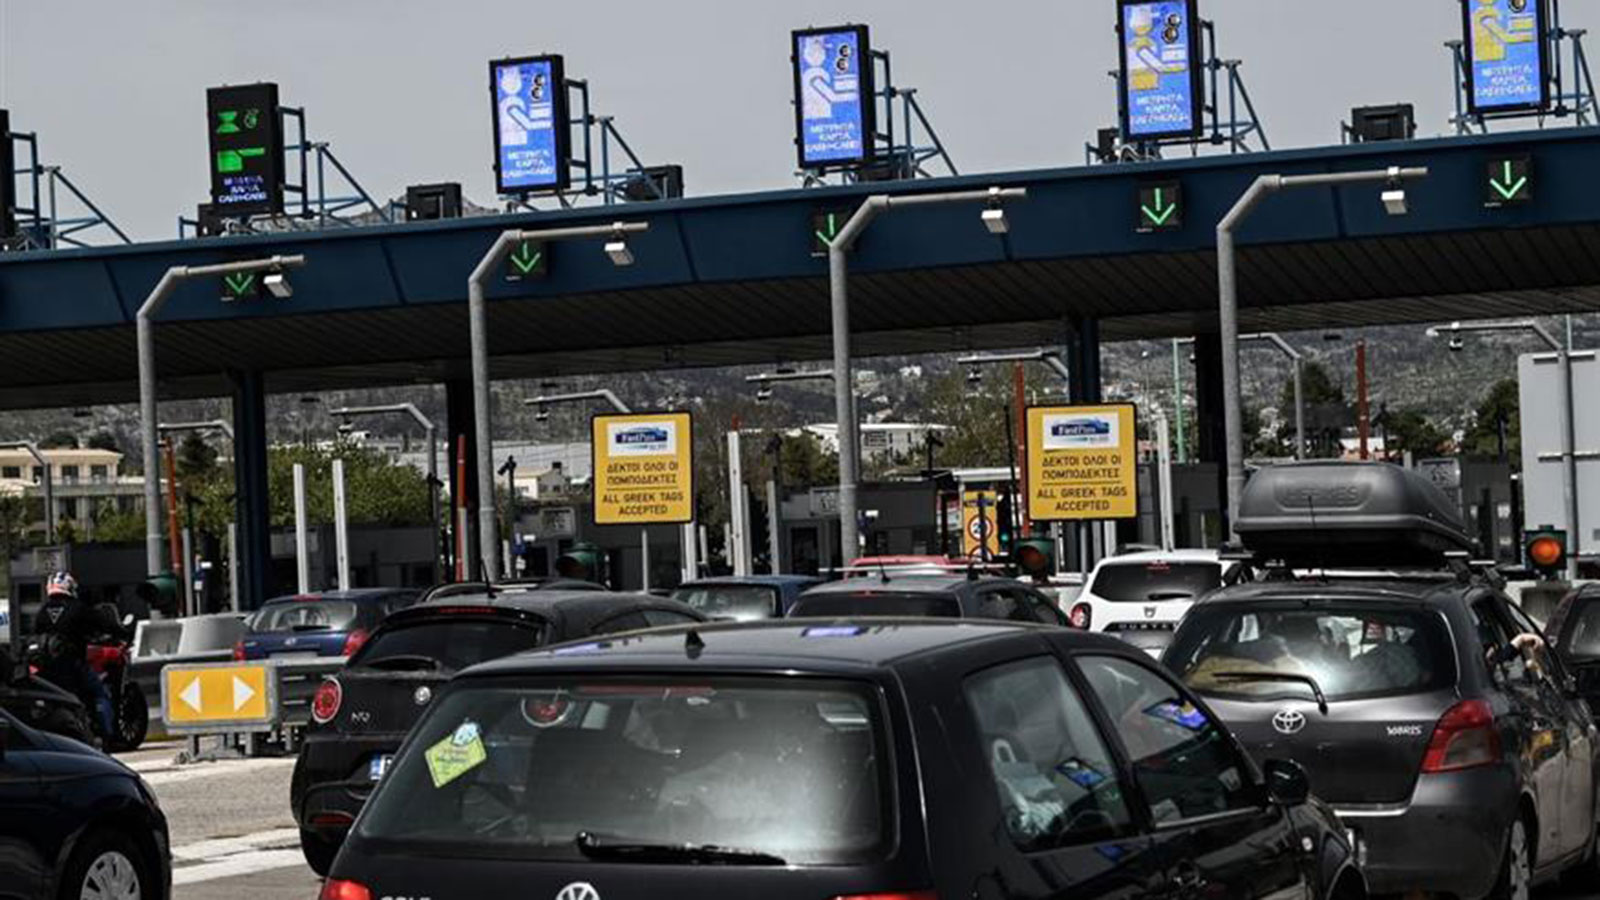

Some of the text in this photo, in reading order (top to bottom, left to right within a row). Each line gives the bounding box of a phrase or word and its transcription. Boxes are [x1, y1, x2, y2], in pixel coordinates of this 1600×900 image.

[607, 461, 679, 473] ΔΕΚΤΟΙ ΟΛΟΙ ΟΙ
[1042, 455, 1122, 467] ΔΕΚΤΟΙ ΟΛΟΙ ΟΙ
[602, 491, 684, 503] ALL GREEK TAGS
[1037, 486, 1128, 498] ALL GREEK TAGS
[619, 505, 668, 516] ACCEPTED
[1055, 500, 1110, 511] ACCEPTED
